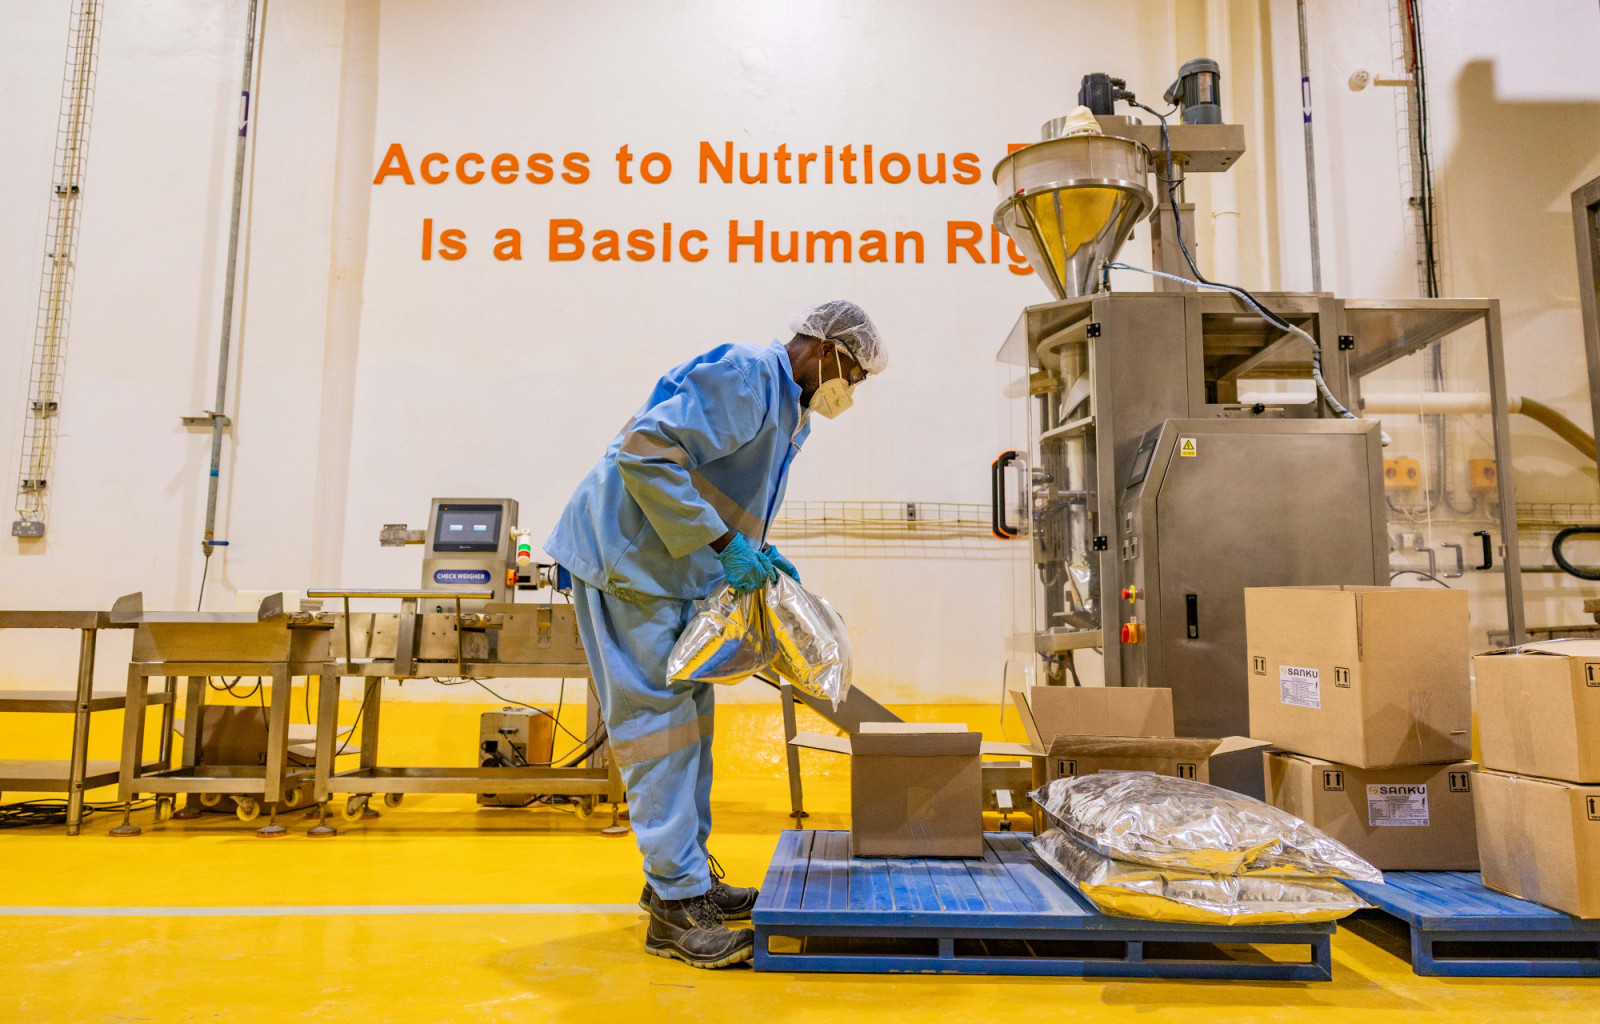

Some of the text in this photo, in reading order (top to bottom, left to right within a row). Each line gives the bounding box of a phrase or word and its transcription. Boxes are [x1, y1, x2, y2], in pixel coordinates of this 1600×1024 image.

[373, 141, 982, 185] Access to Nutritious
[421, 218, 1035, 276] Is a Basic Human Rig
[1287, 668, 1319, 679] SANKU
[1380, 786, 1426, 795] SANKU
